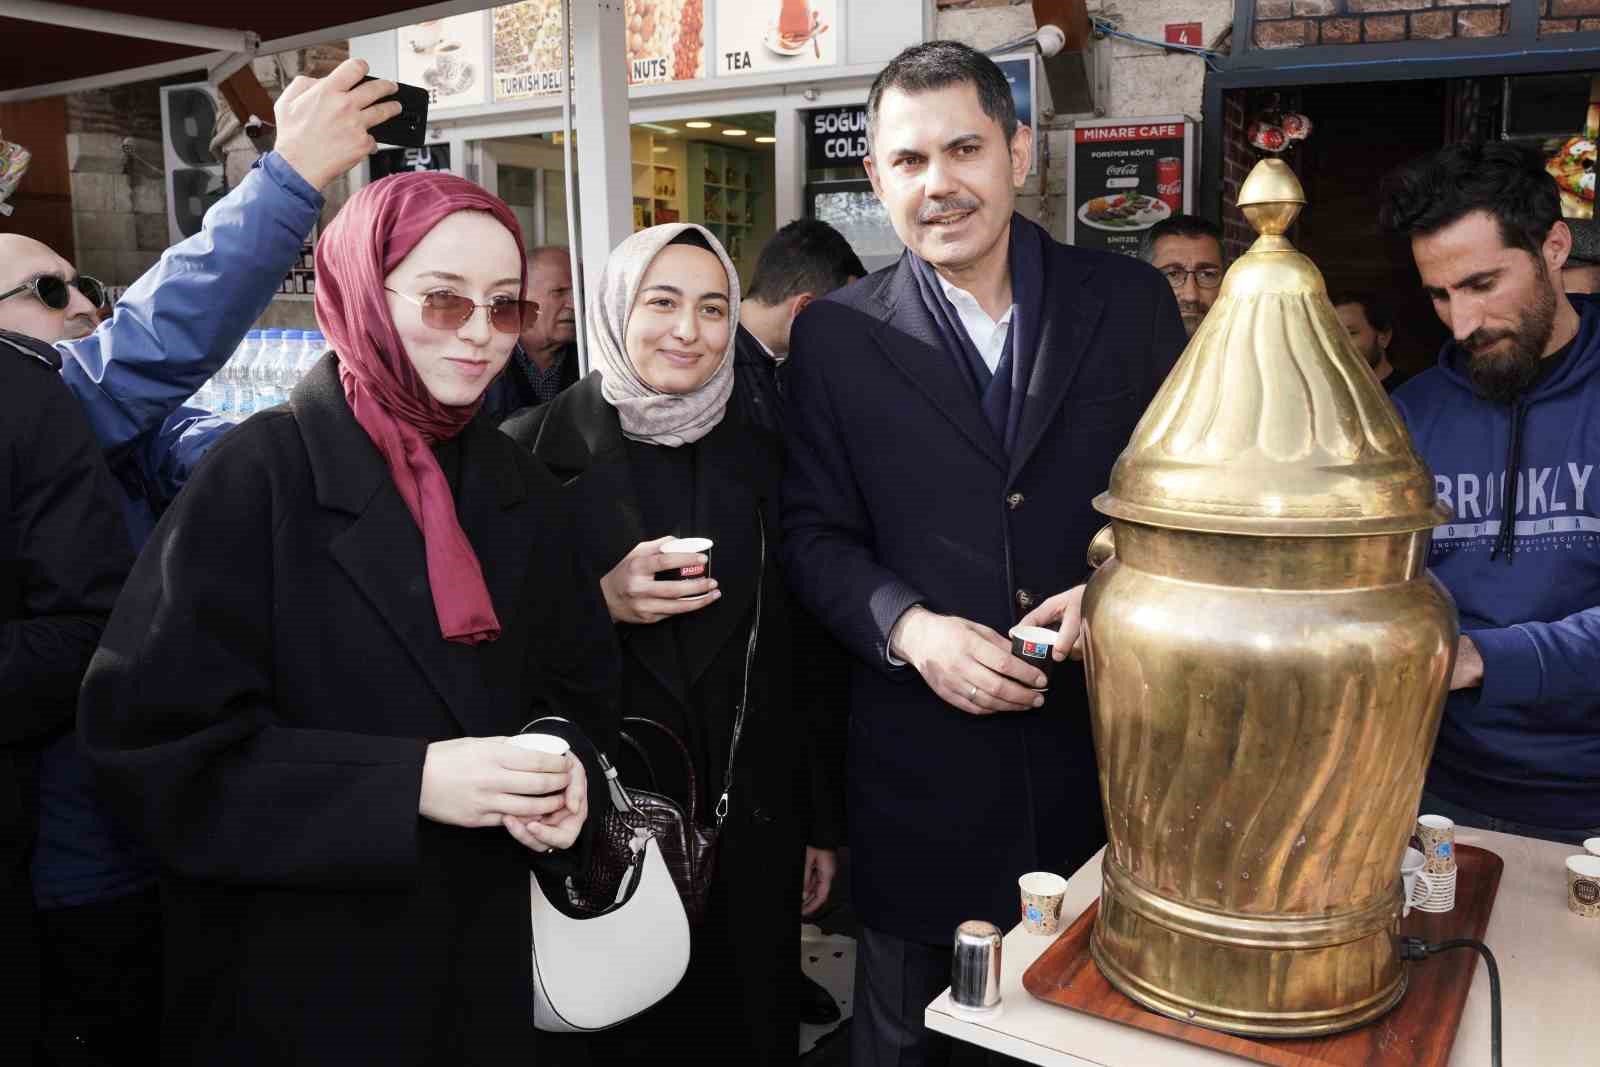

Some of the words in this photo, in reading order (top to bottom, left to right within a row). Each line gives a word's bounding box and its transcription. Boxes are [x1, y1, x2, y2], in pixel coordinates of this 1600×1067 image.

[1178, 31, 1188, 45] 4
[633, 59, 666, 79] NUTS
[726, 51, 752, 71] TEA
[501, 73, 540, 96] TURKISH
[1140, 125, 1177, 137] CAFE
[825, 137, 867, 158] COLD
[1433, 461, 1599, 519] BROOKLY
